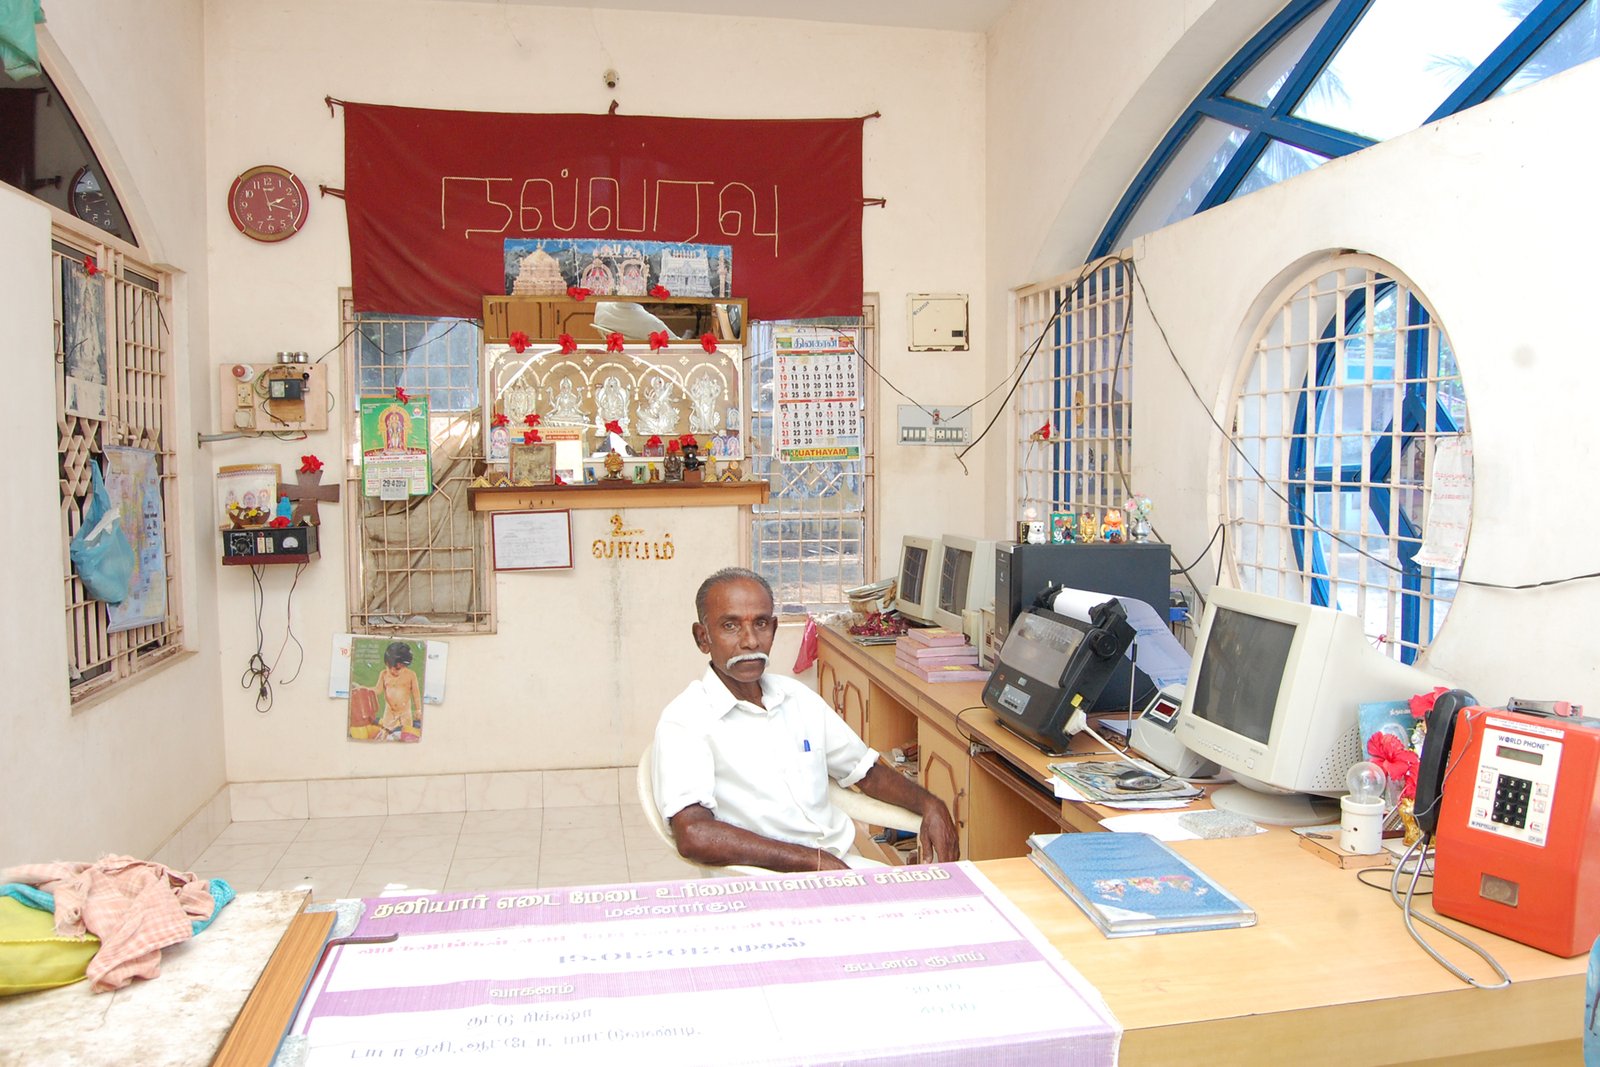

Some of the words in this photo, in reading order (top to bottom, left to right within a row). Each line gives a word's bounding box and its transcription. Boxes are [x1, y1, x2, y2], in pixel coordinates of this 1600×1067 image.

[253, 181, 260, 189] 11
[263, 177, 272, 186] 12
[278, 180, 282, 188] 1
[245, 190, 254, 198] 10
[286, 187, 292, 195] 2
[292, 200, 298, 208] 3
[246, 213, 253, 221] 8
[287, 211, 294, 219] 4
[442, 168, 778, 258] நல்வரவு
[258, 221, 263, 229] 7
[592, 533, 675, 560] லாபம்
[1498, 735, 1522, 746] WORLD
[1523, 740, 1545, 750] PHONE
[370, 894, 490, 919] தனியார்
[497, 894, 562, 909] எடை
[569, 888, 649, 904] மேடை
[655, 870, 866, 898] உரிமையாளர்கள்
[873, 865, 952, 885] சங்கம்
[604, 900, 748, 918] மன்னார்குடி
[490, 983, 574, 999] வாகனம்
